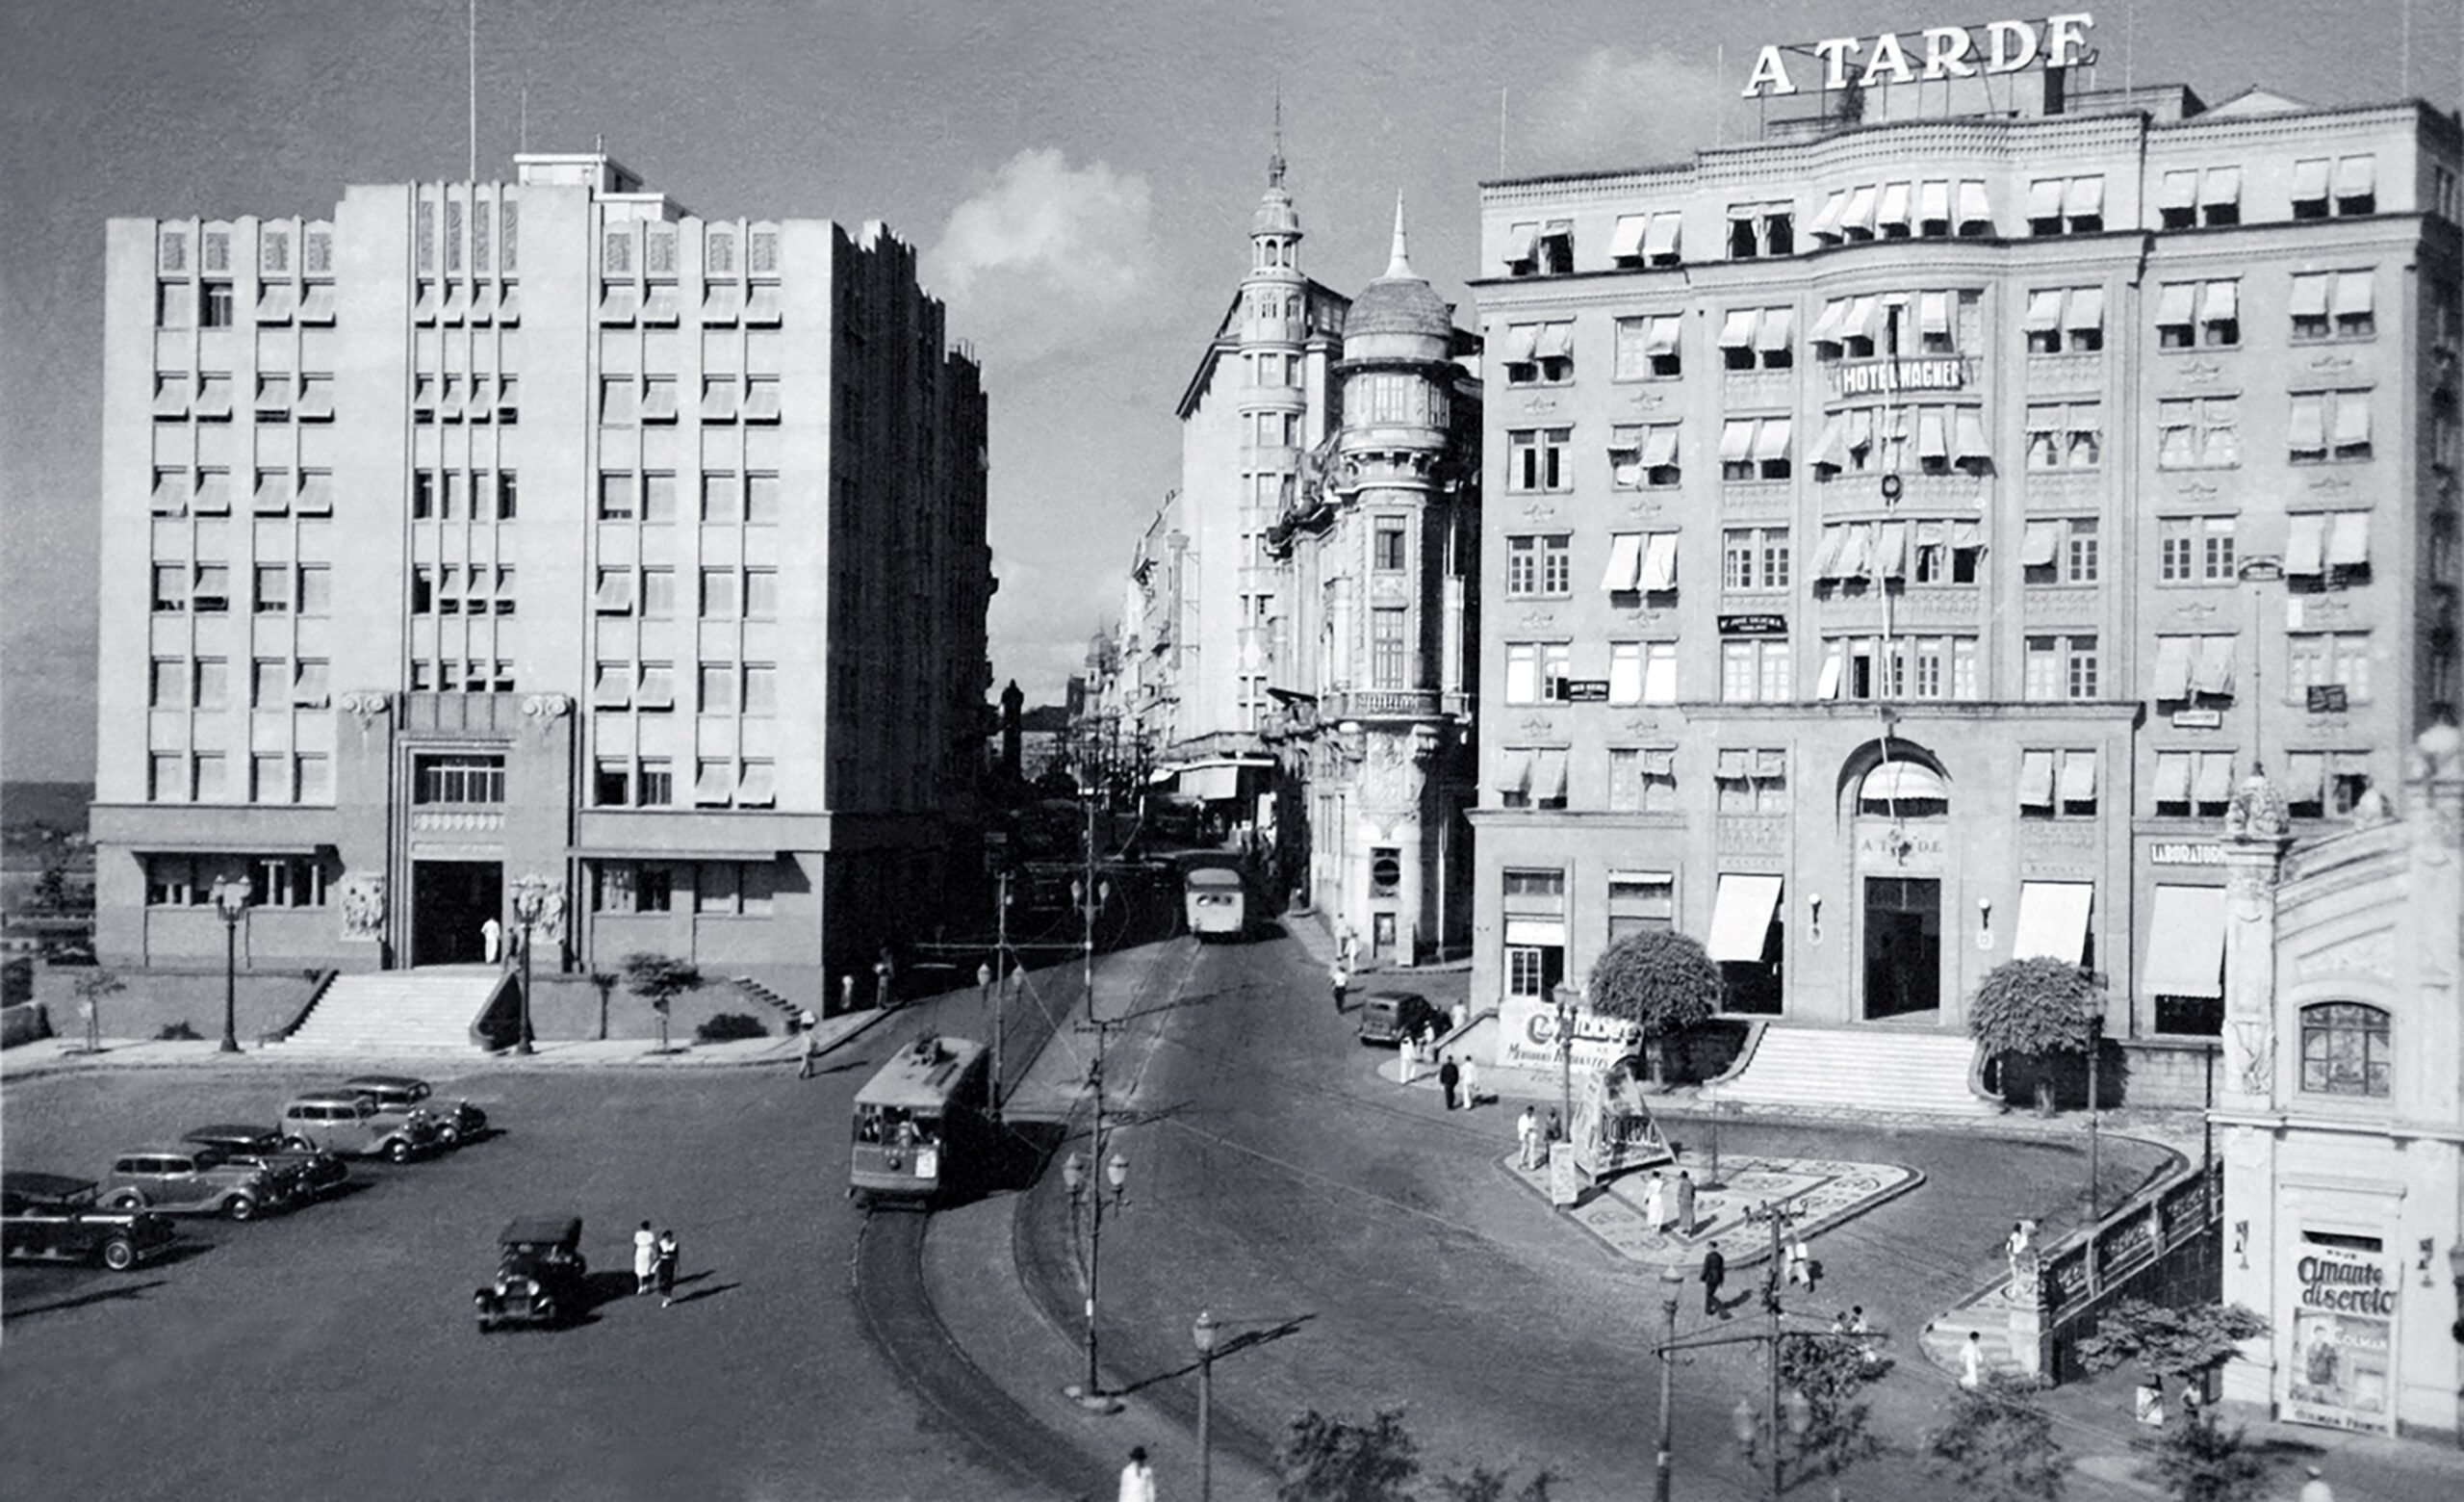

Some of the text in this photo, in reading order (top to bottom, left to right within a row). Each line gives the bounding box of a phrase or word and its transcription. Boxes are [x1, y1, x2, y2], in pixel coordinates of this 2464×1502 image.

[1742, 13, 2099, 97] A TARDE
[1843, 365, 1898, 393] HOTEL
[1880, 840, 1942, 853] TDE
[2302, 1284, 2397, 1314] discreto
